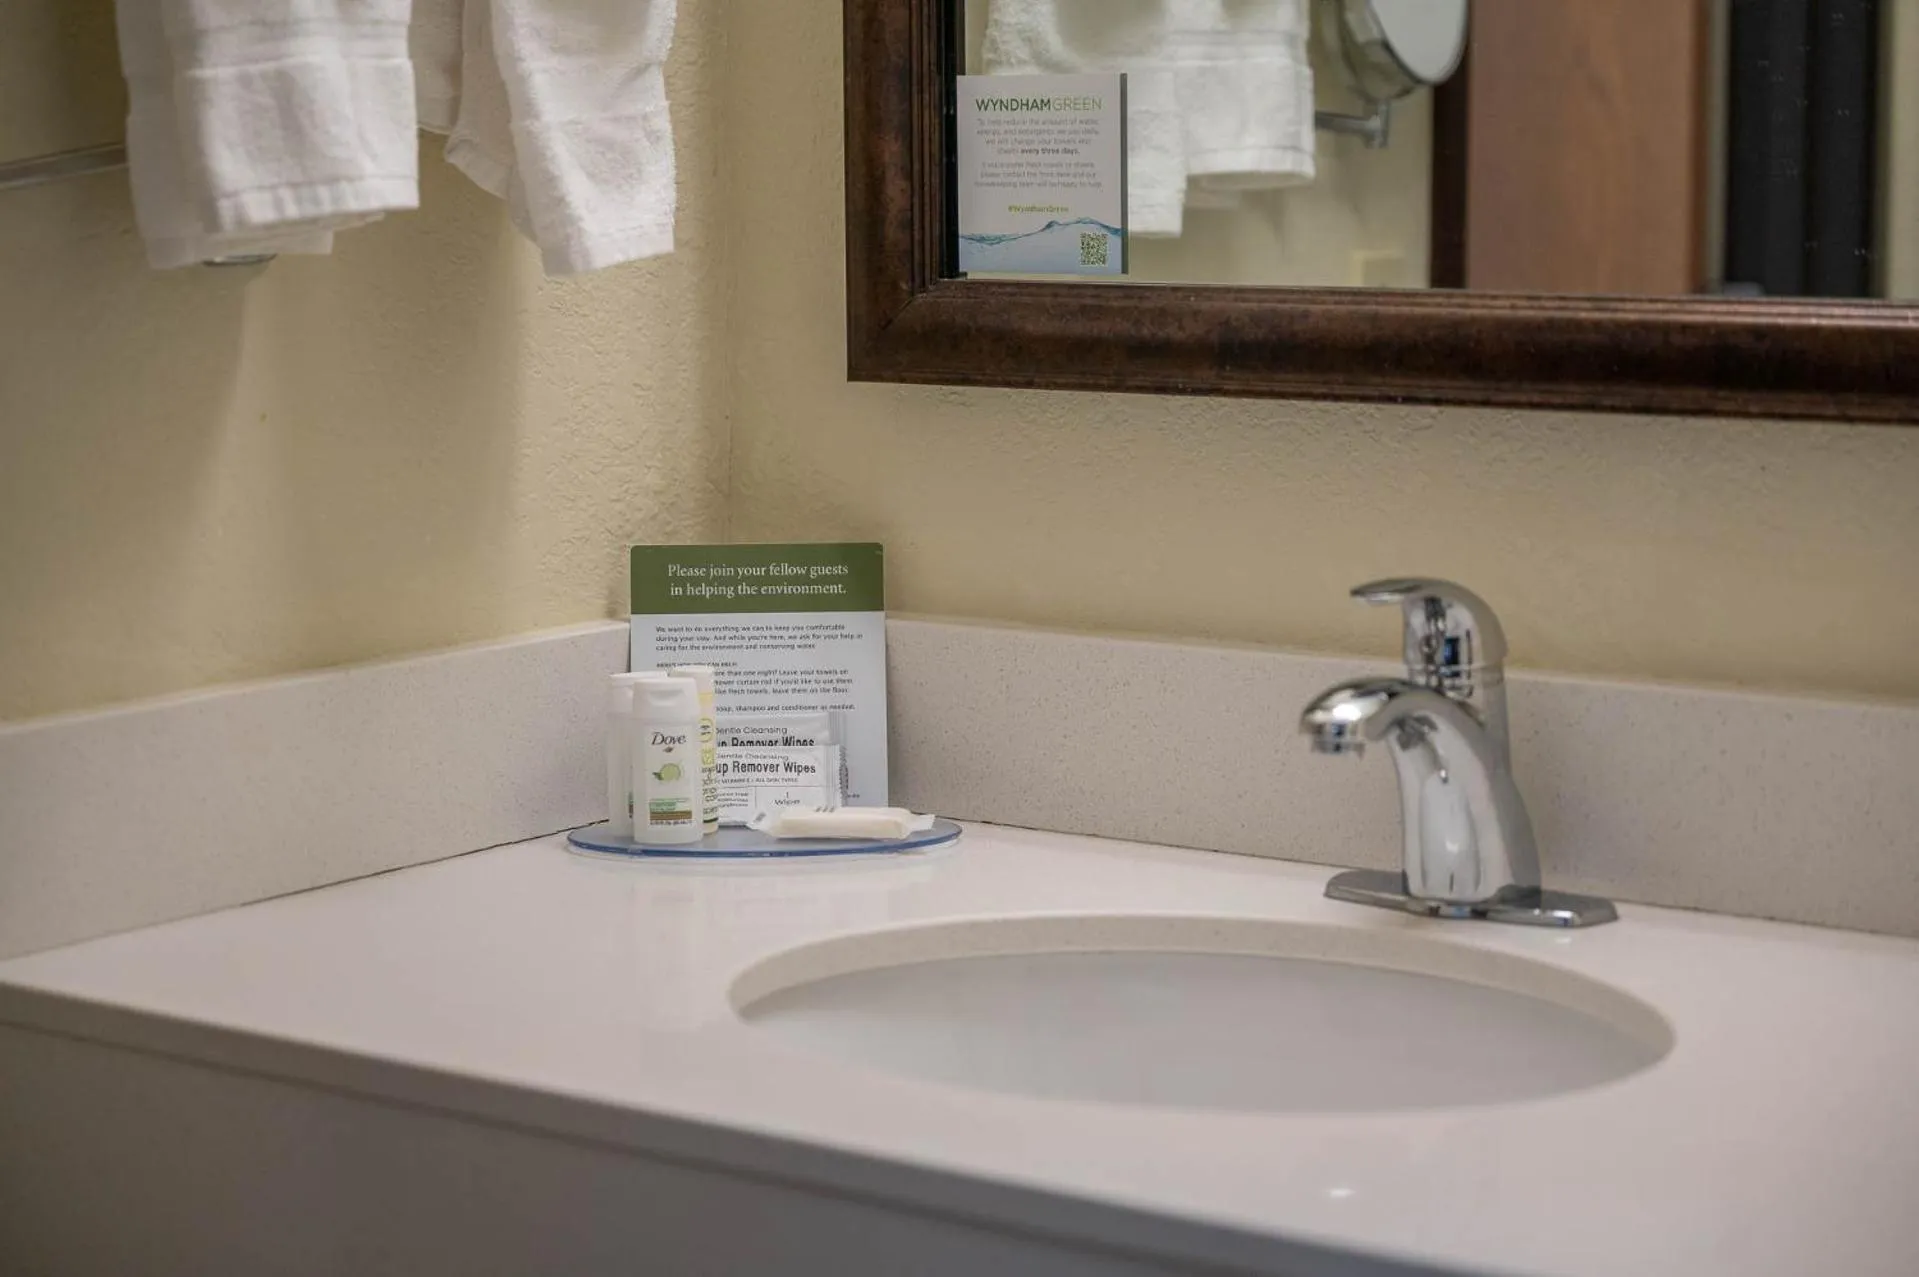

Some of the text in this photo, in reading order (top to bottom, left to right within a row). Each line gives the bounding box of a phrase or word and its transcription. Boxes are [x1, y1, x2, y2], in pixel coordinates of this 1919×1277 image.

[668, 562, 849, 580] Please join your fellow guests
[670, 582, 847, 599] in helping the environment.
[651, 732, 687, 745] Dove
[743, 726, 788, 735] Cleansing
[732, 760, 780, 774] Remover
[783, 761, 816, 776] Wipes
